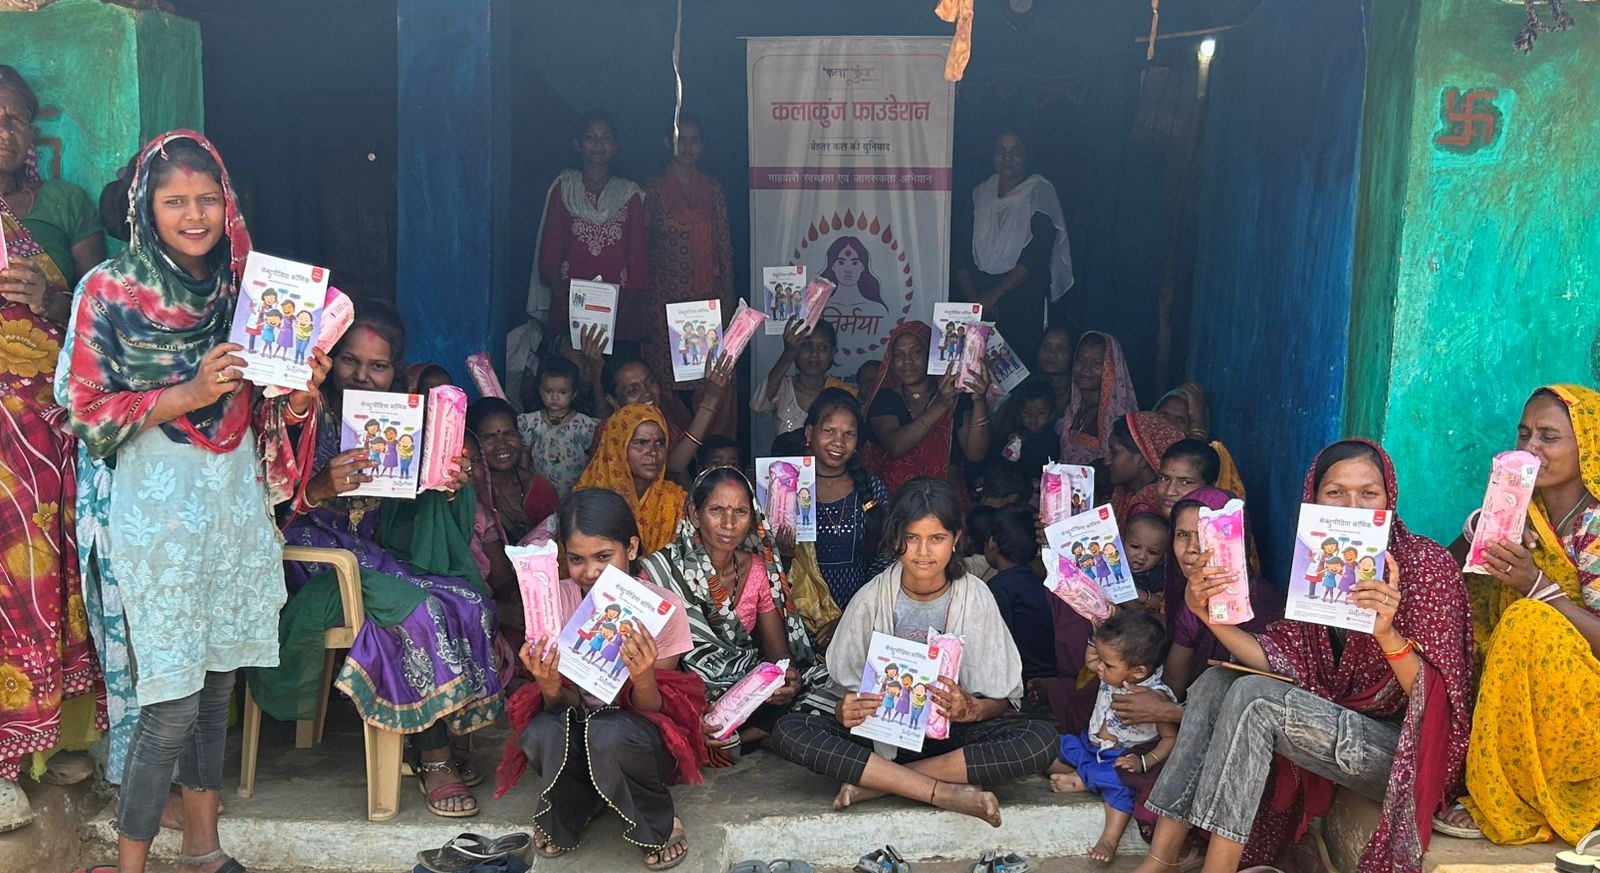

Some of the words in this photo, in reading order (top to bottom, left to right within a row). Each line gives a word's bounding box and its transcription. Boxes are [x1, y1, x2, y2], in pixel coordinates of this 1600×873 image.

[771, 97, 847, 128] कलाकुंज
[851, 94, 931, 121] फाउंडेशन
[810, 139, 831, 151] बेहतर
[833, 142, 848, 151] कल
[850, 139, 860, 151] की
[768, 171, 799, 183] माहवारी
[803, 173, 834, 184] स्वच्छता
[838, 172, 849, 183] एवं
[854, 173, 896, 184] जागरूकता
[899, 171, 933, 184] अभियान
